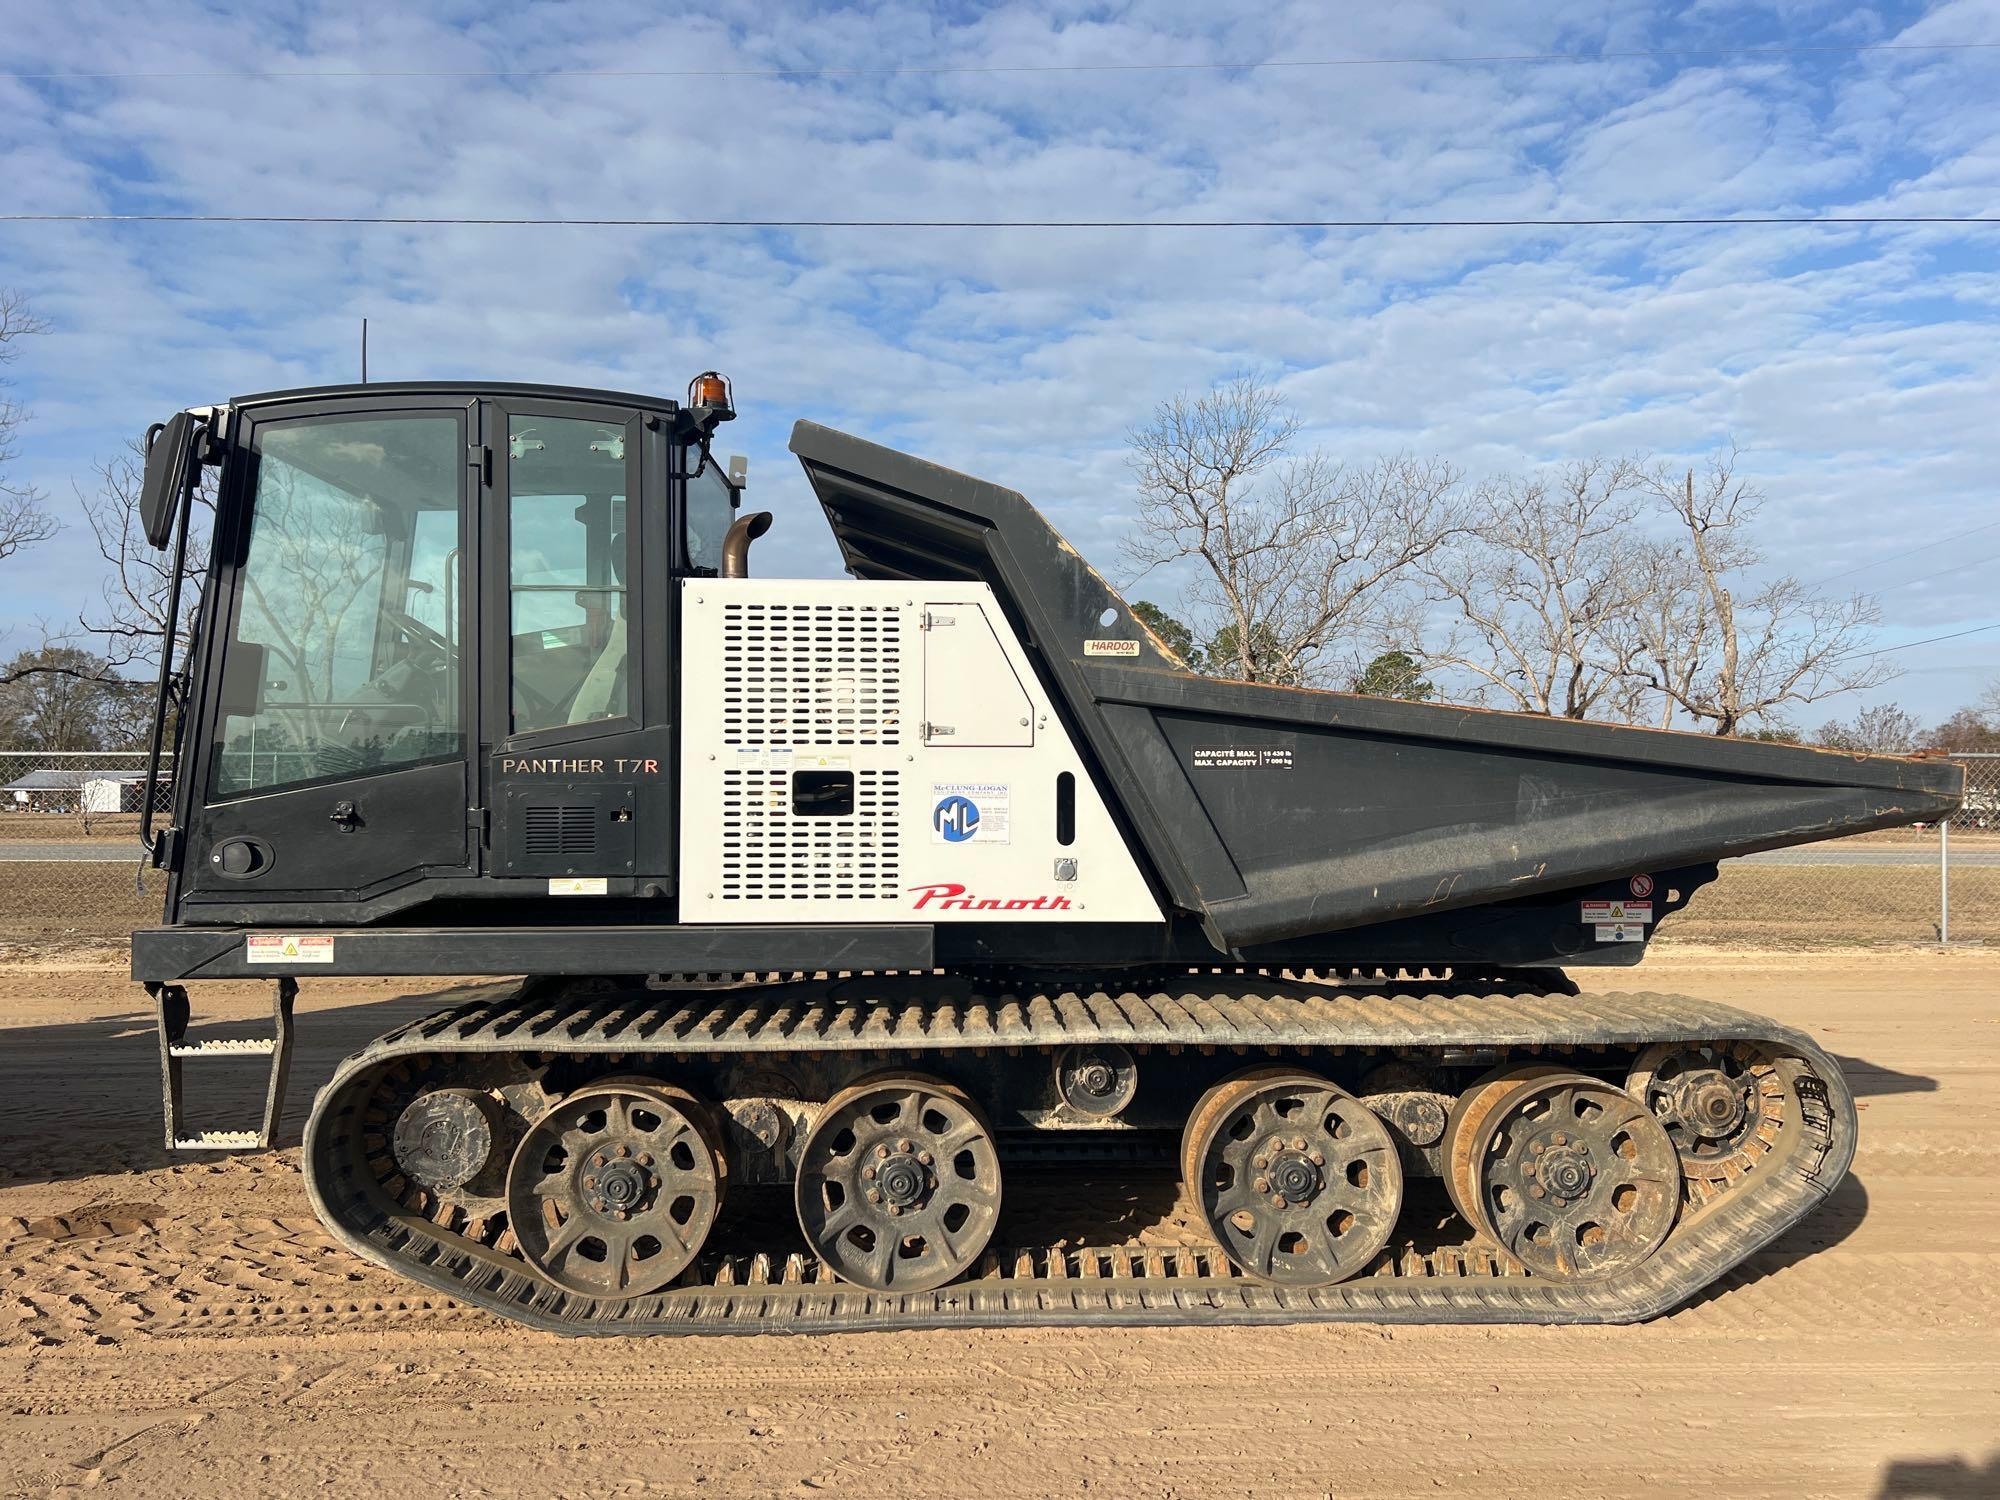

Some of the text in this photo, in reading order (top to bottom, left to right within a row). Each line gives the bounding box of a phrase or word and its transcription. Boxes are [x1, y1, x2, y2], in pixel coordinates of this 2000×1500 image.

[1091, 641, 1136, 651] HARDOX
[502, 759, 659, 773] PANTHER T7R
[907, 883, 1072, 910] Prinoth
